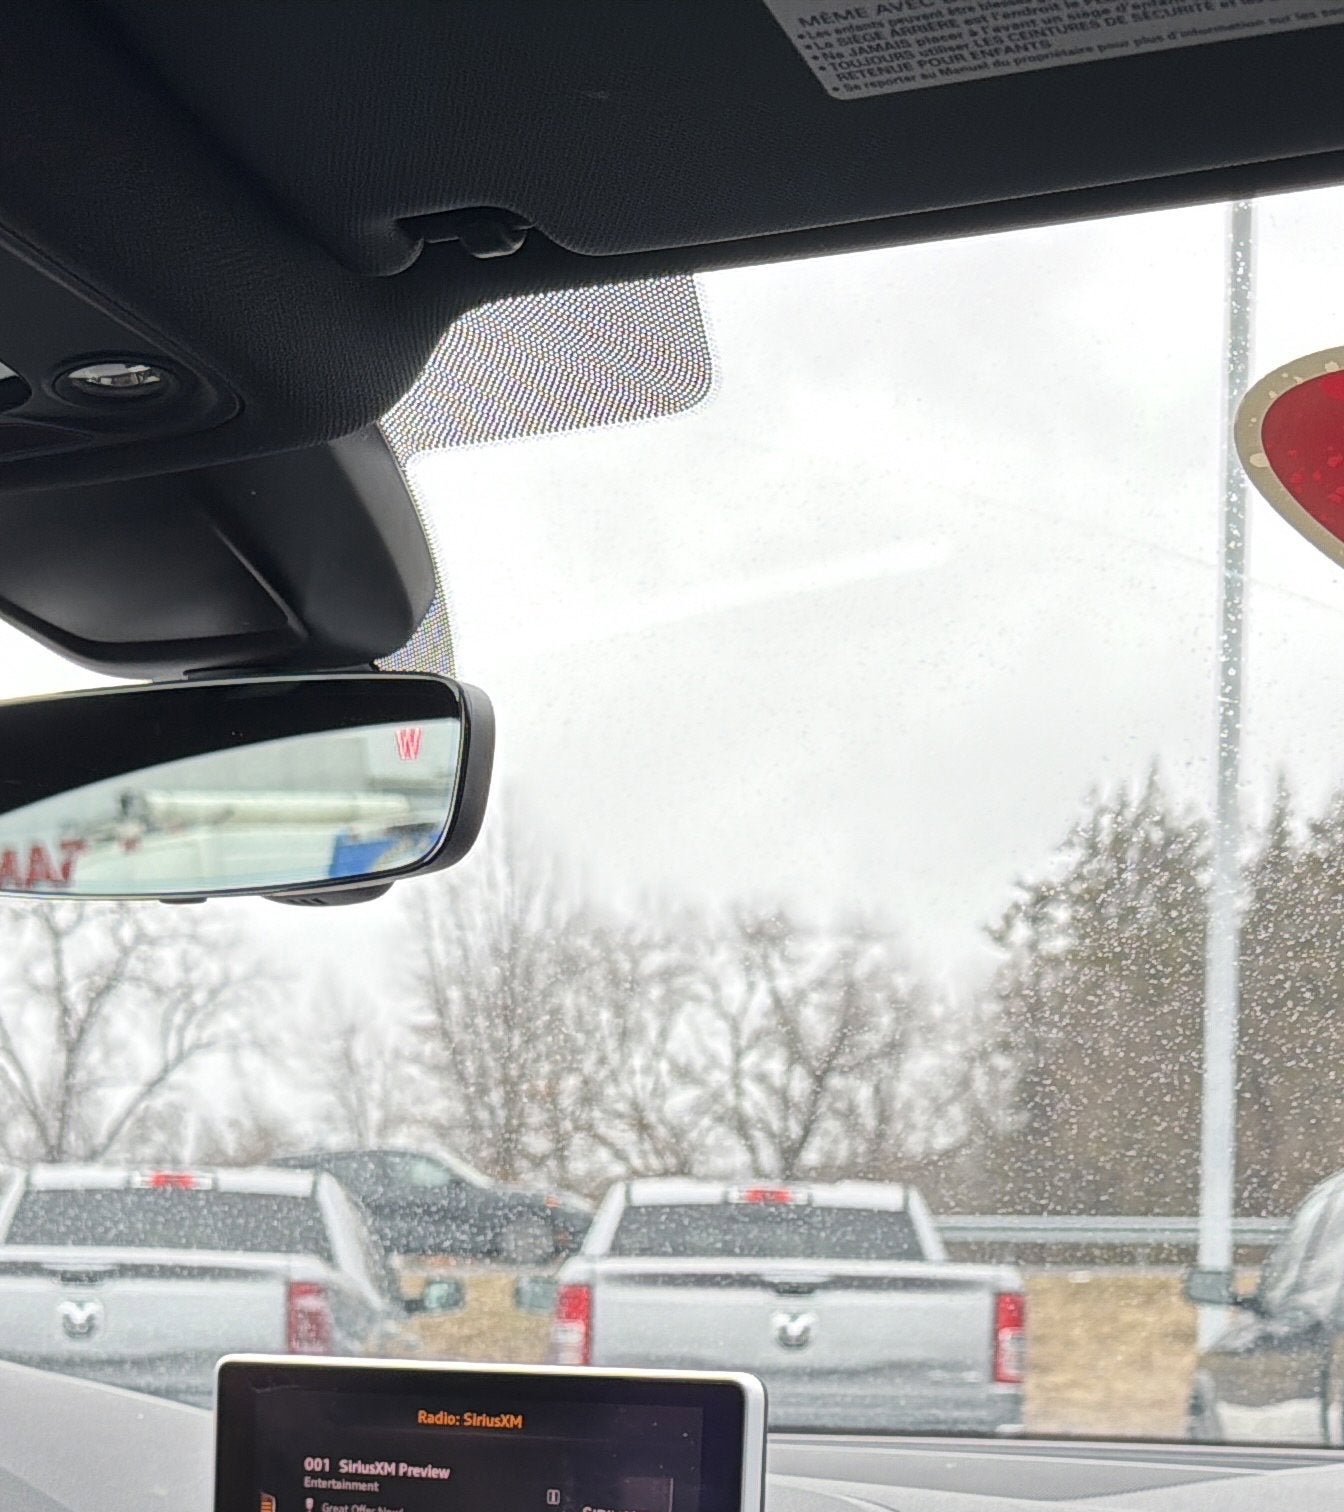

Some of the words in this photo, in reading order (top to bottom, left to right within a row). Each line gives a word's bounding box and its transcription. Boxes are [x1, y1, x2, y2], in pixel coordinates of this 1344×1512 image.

[829, 50, 916, 71] TOUJOURS
[1007, 20, 1100, 41] CEINTURES
[848, 39, 912, 57] JAMAIS
[836, 62, 914, 82] RETENUE
[917, 53, 967, 70] POUR
[969, 39, 1052, 60] ENFANTS
[416, 1408, 461, 1427] Radio:
[462, 1409, 523, 1430] SiriusXM
[303, 1456, 331, 1474] 001
[338, 1457, 396, 1478] SiriusXM
[397, 1460, 452, 1481] Preview
[303, 1476, 380, 1494] Entertainment
